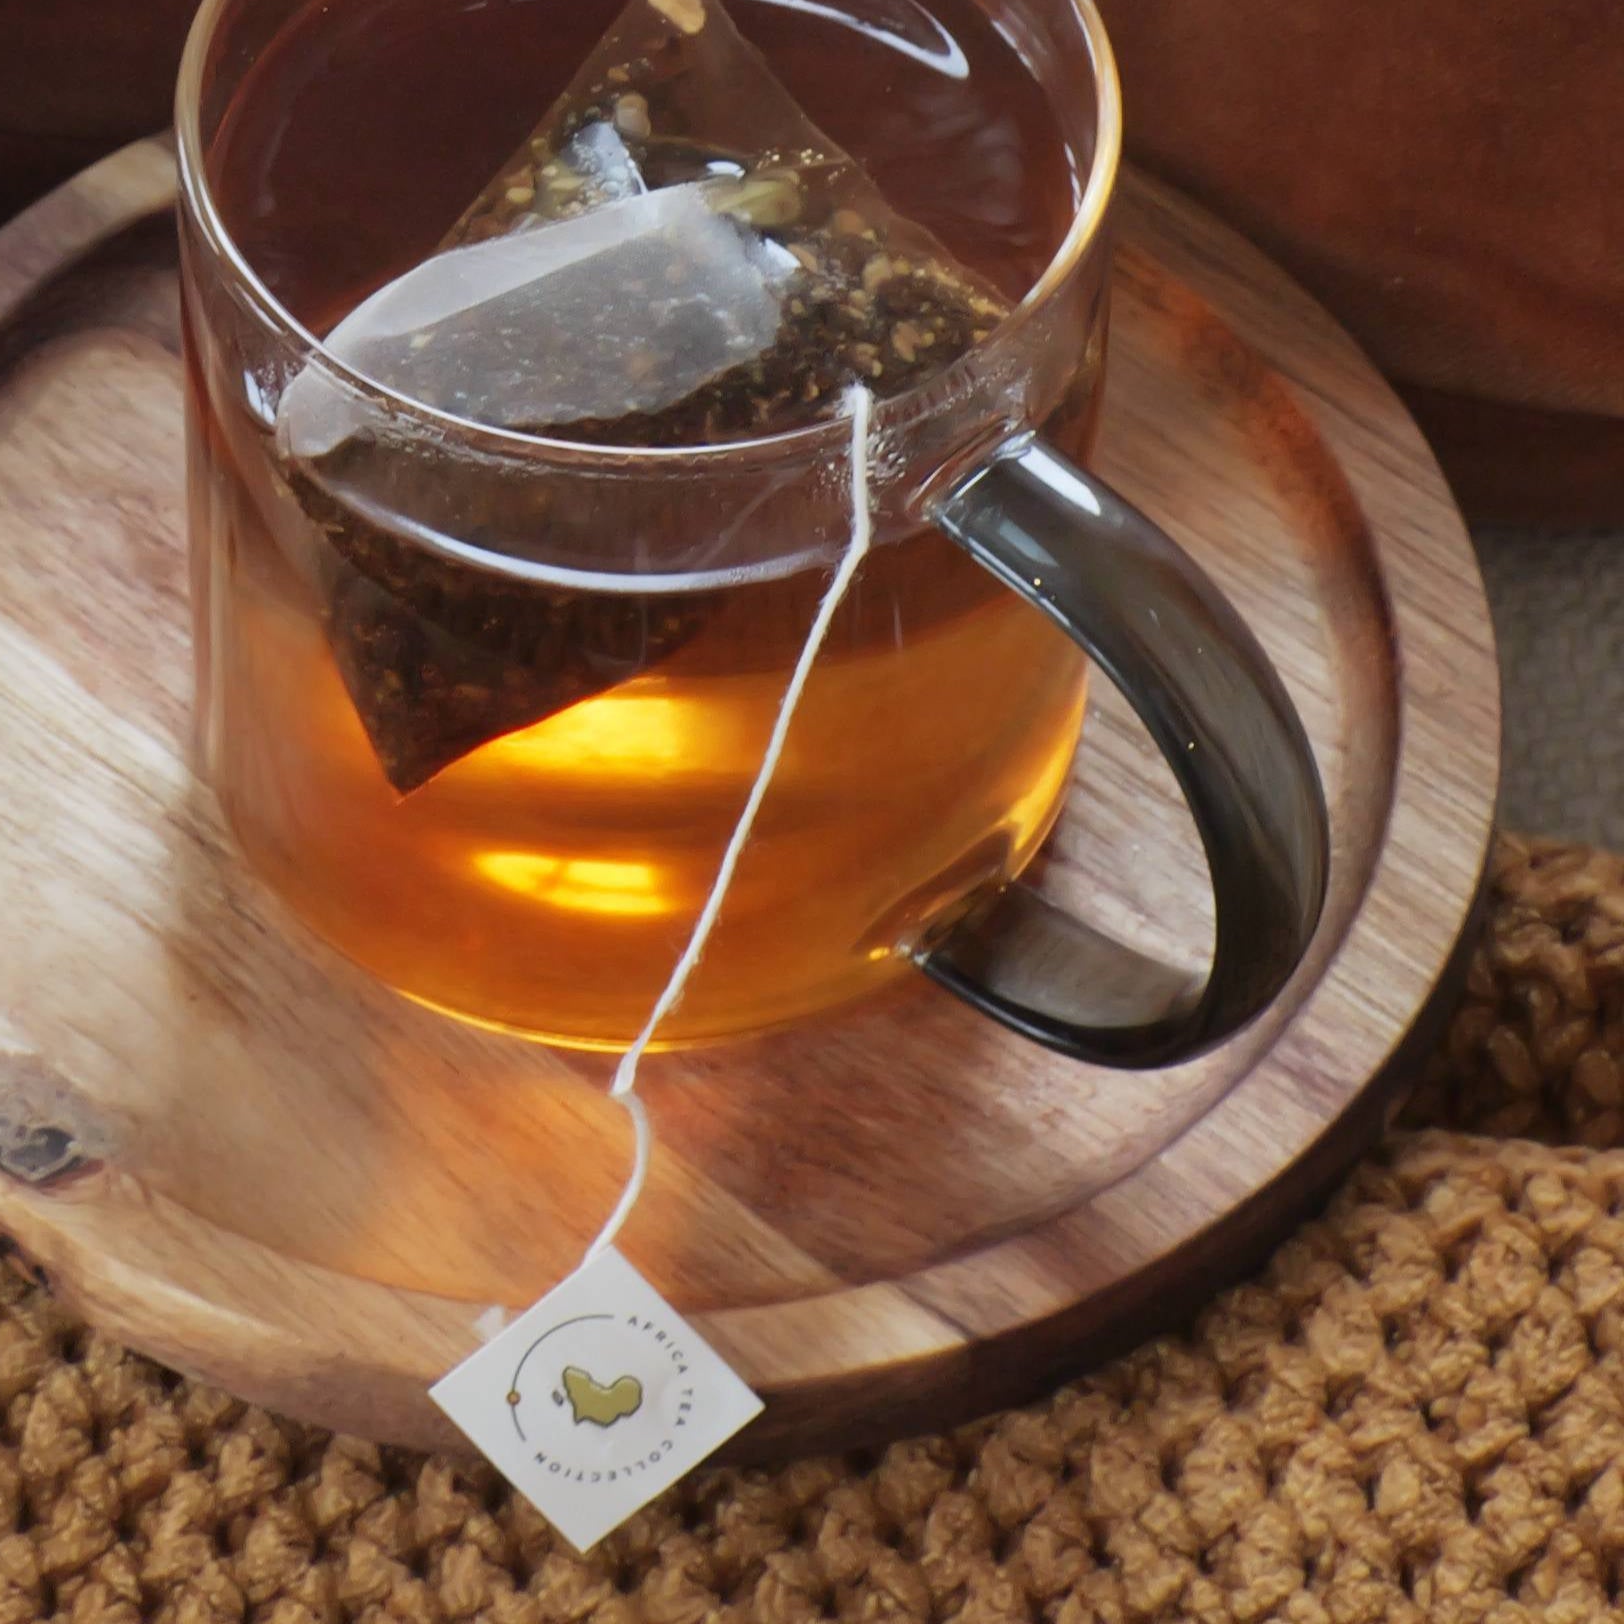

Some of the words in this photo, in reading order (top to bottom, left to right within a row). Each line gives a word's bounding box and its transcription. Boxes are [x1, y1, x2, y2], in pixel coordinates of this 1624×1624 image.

[628, 1316, 688, 1373] AFRICA
[675, 1388, 693, 1426] TEA
[535, 1439, 674, 1483] COLLECTION
